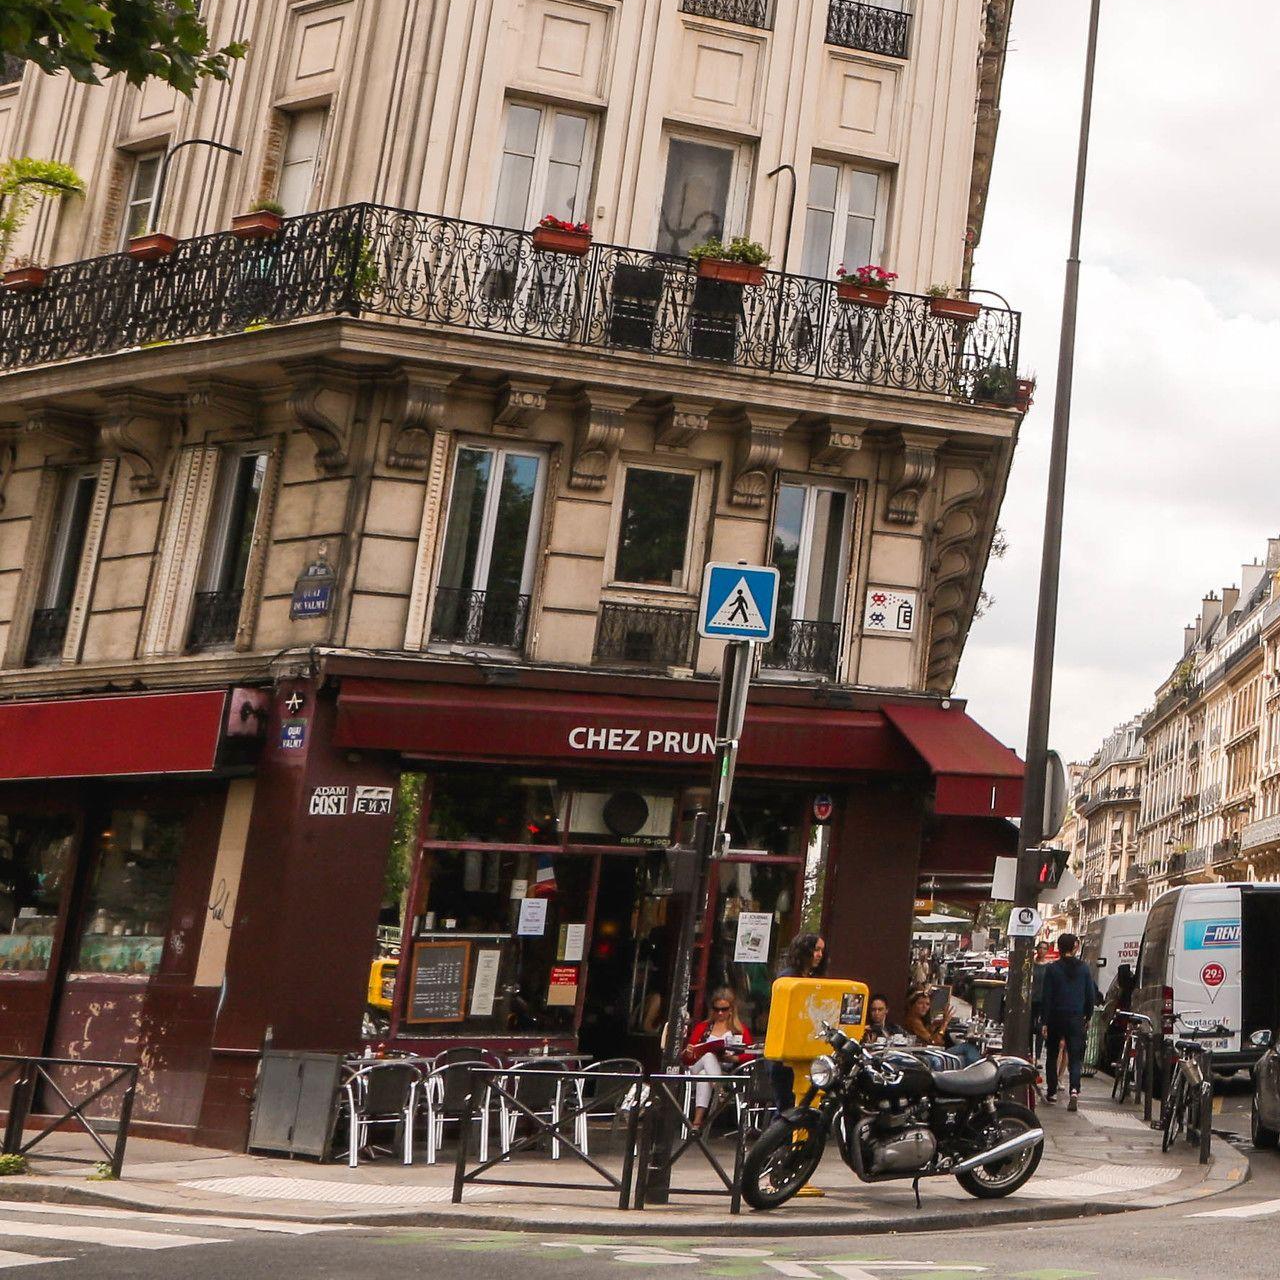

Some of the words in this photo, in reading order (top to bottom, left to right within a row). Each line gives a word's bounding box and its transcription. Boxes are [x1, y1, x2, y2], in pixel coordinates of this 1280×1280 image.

[287, 726, 302, 736] QUAI
[282, 739, 303, 748] VALMY
[568, 727, 641, 752] CHEZ
[646, 730, 716, 755] PRUN
[313, 786, 346, 796] ADAM
[309, 795, 348, 816] COST
[1214, 926, 1241, 941] RENT
[1118, 950, 1138, 958] TOUS
